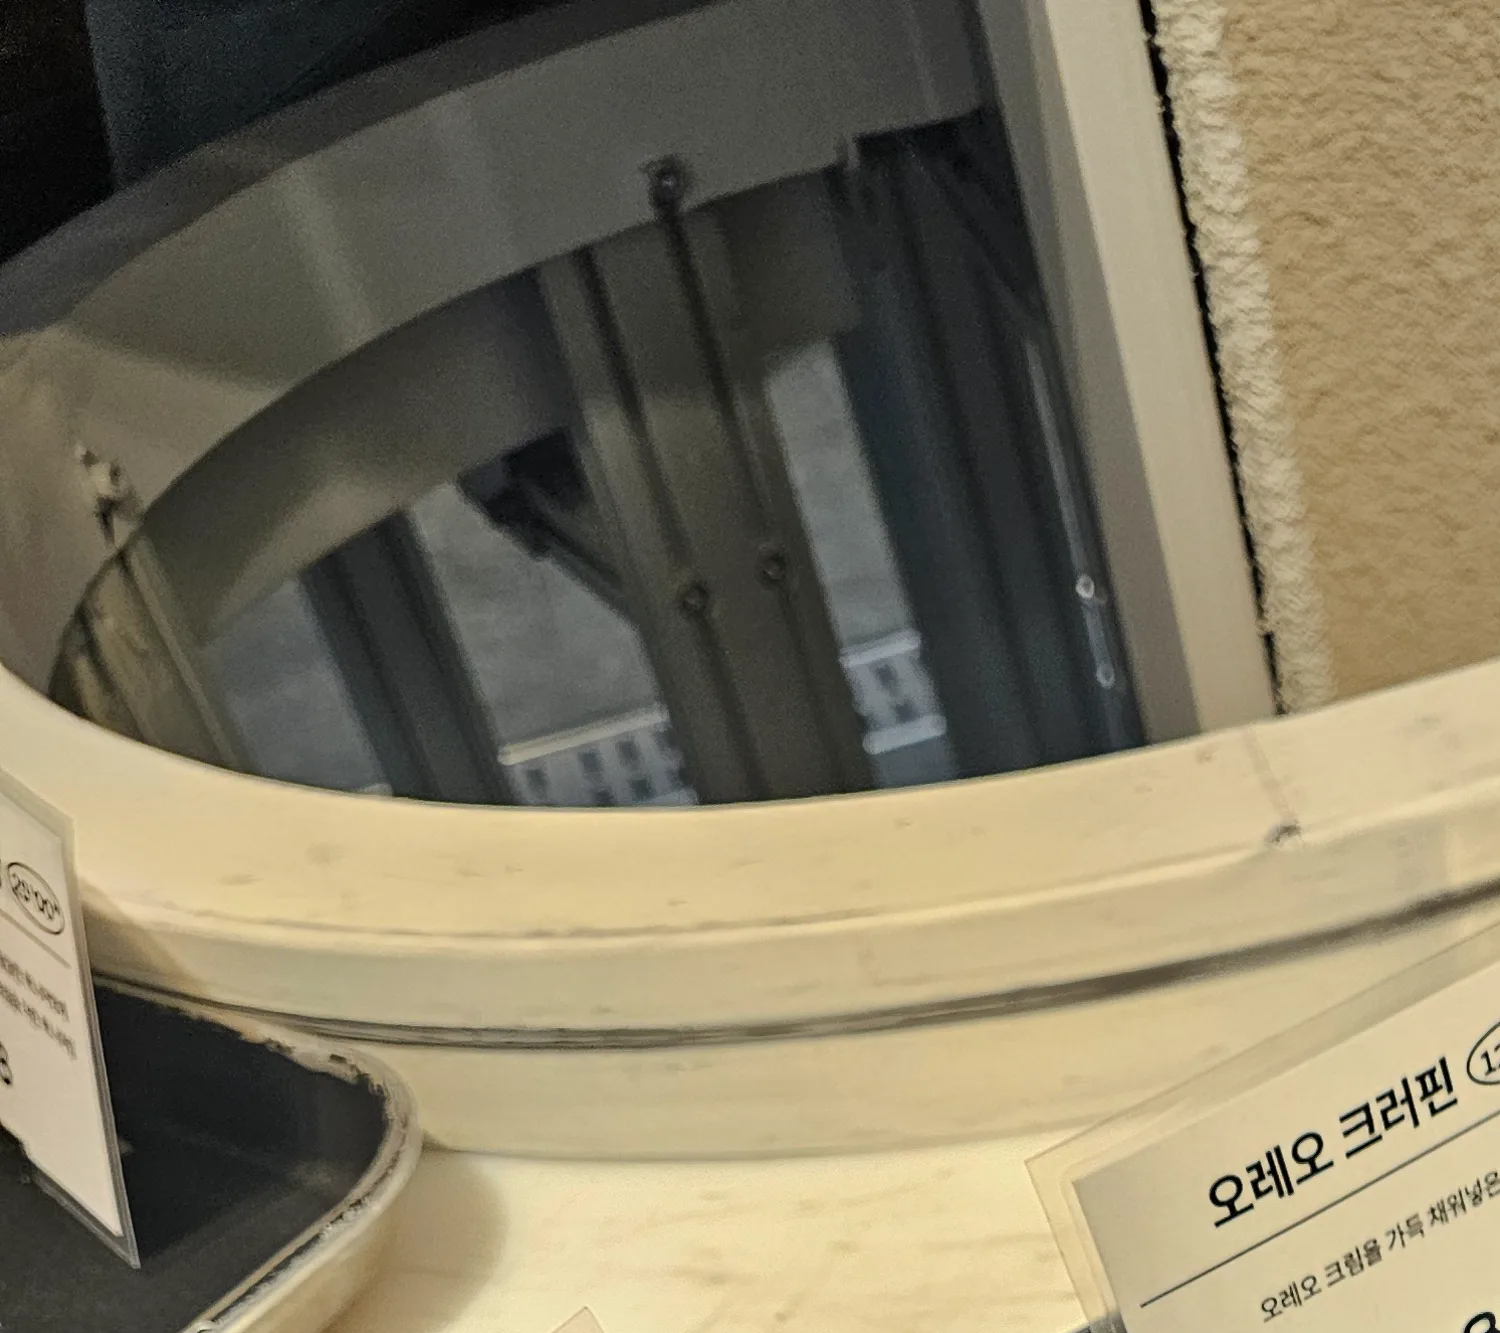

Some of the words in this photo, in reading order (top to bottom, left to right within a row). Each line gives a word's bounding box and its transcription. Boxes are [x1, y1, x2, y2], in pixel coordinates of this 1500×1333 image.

[1207, 1131, 1335, 1229] 오레오
[1338, 1056, 1459, 1158] 크러핀
[1260, 1273, 1323, 1324] 오레오
[1323, 1237, 1384, 1289] 크림을
[1384, 1211, 1426, 1252] 가득
